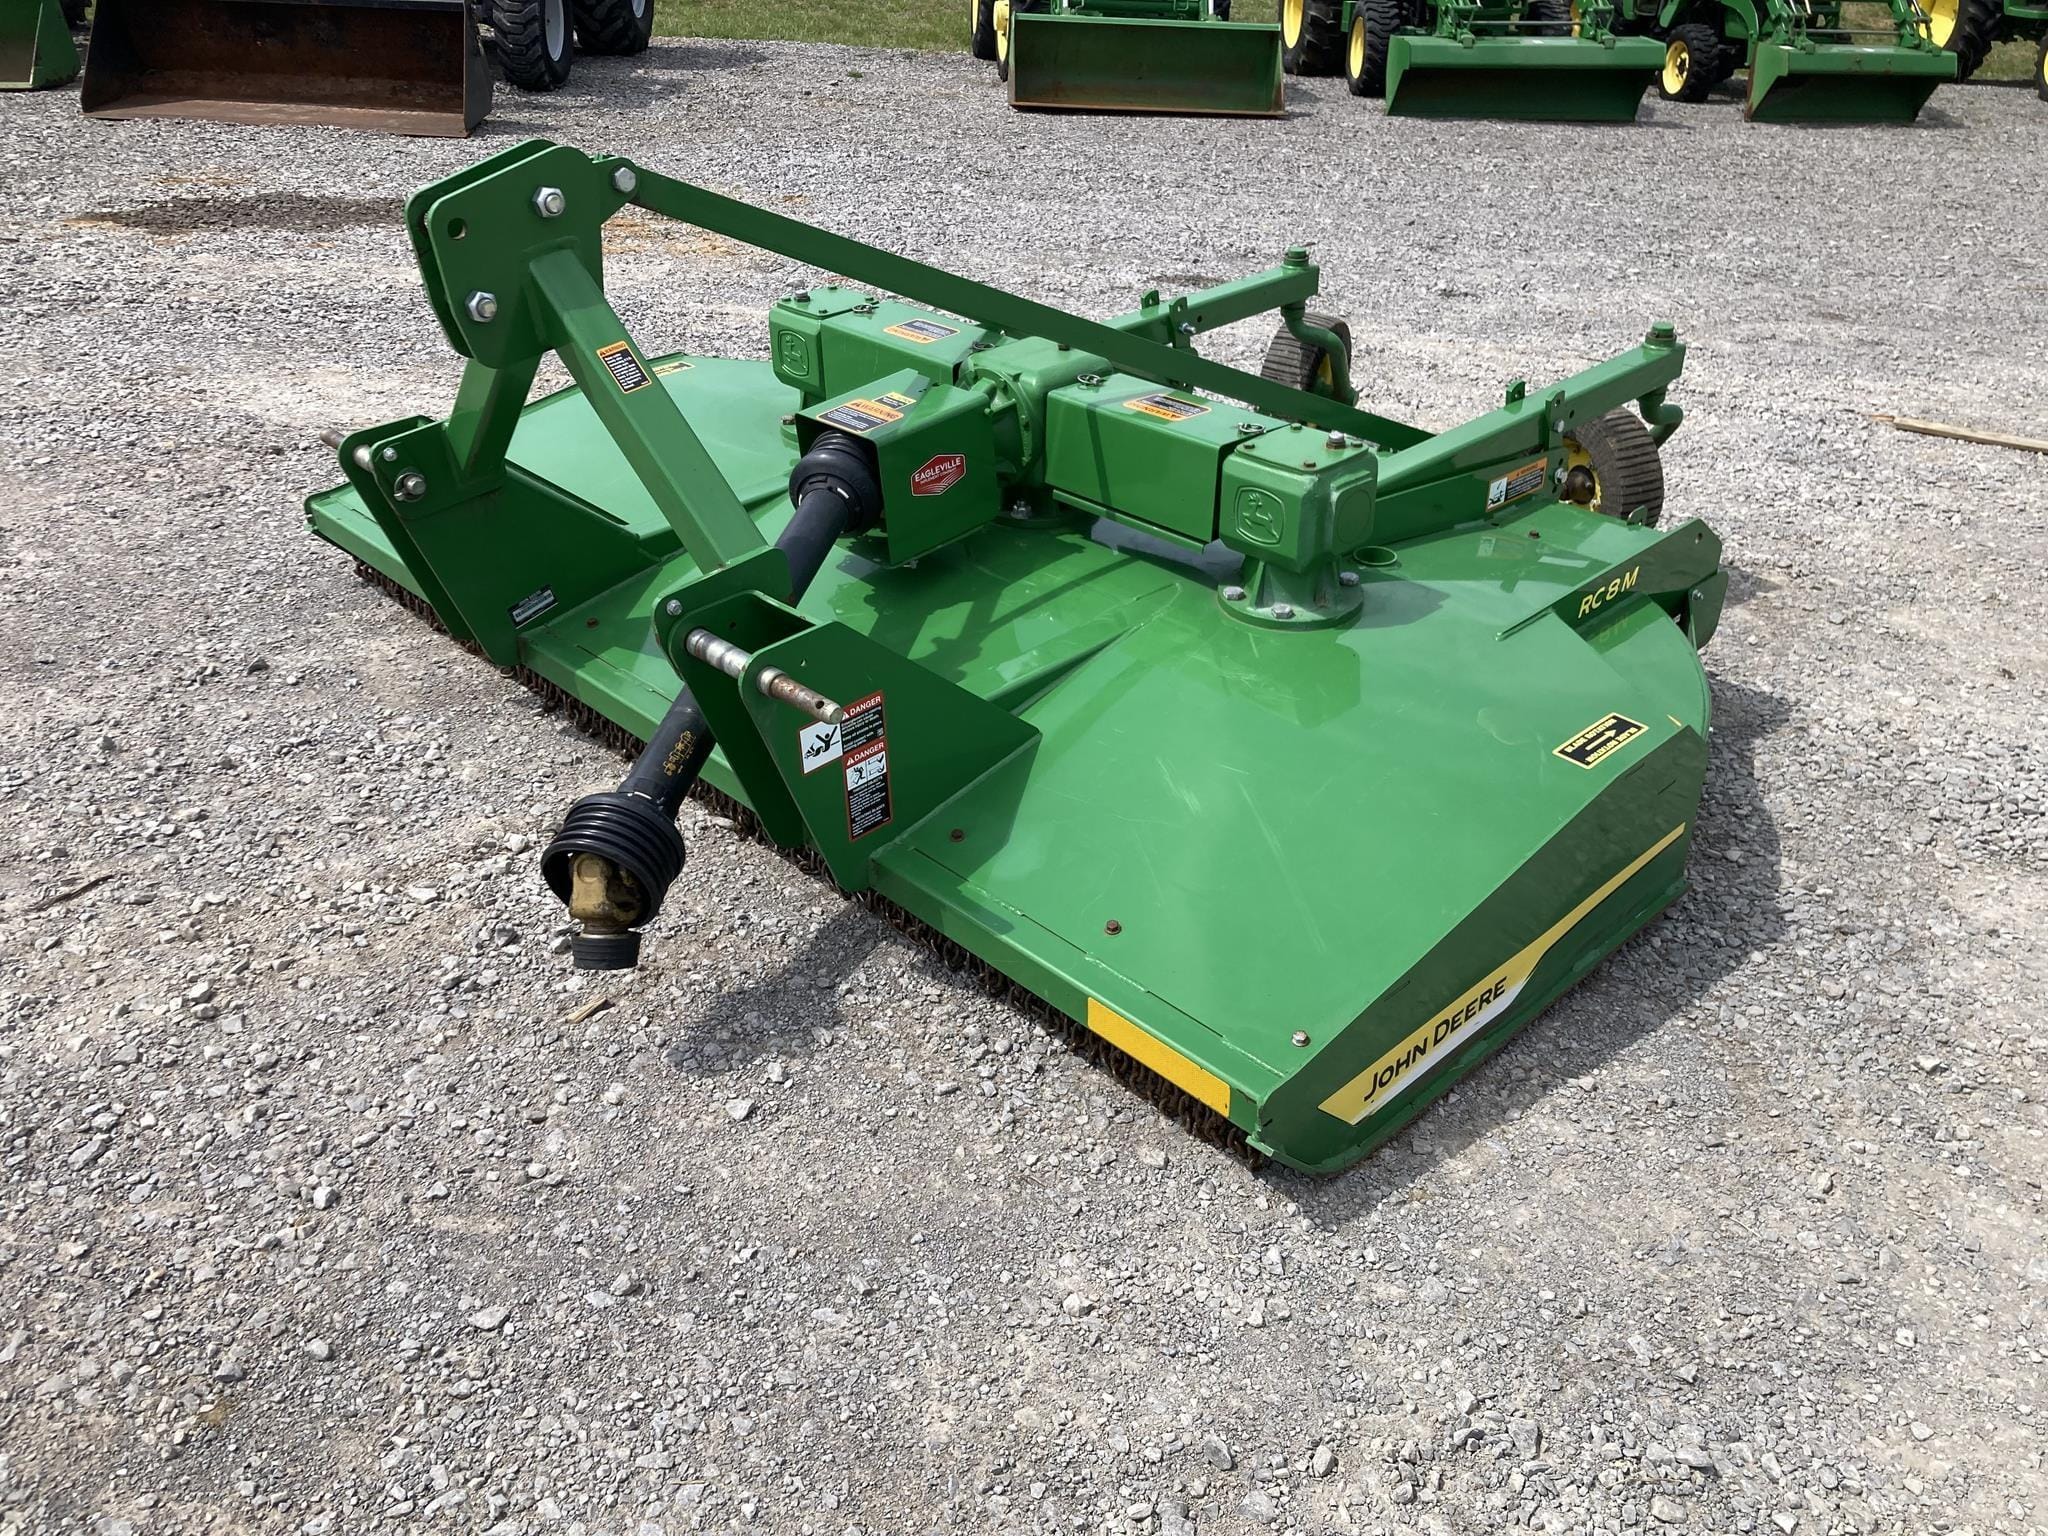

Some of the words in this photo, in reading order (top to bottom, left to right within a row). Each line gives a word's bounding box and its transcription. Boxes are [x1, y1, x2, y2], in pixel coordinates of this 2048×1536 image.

[915, 457, 961, 482] EAGLEVILLE
[850, 695, 882, 716] DANGER
[854, 741, 885, 762] DANGER
[1363, 1036, 1429, 1103] JOHN
[1433, 976, 1508, 1048] DEERE
